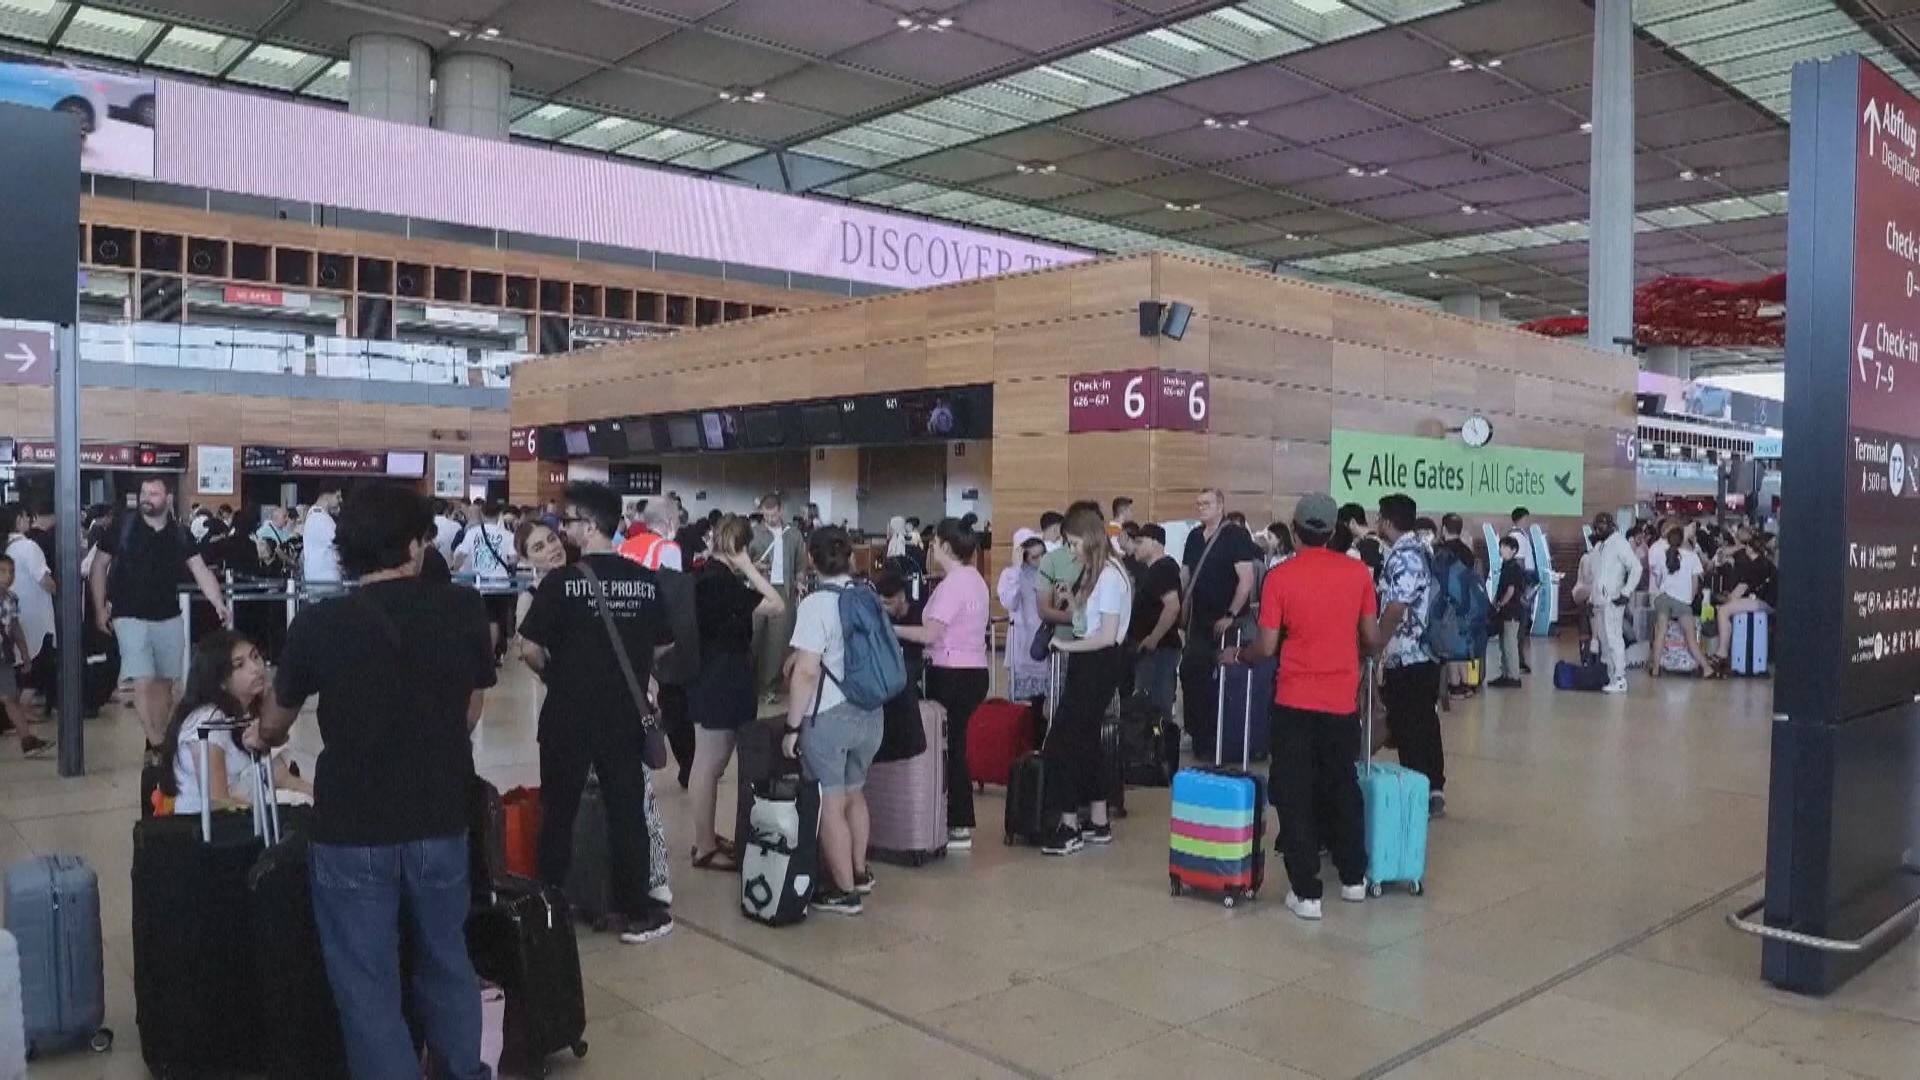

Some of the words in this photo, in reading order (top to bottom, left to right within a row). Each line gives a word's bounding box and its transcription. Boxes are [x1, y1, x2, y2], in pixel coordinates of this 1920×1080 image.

[1882, 102, 1916, 158] Abflug
[841, 220, 1012, 282] DISCOVER
[1877, 322, 1918, 363] Check-in
[1073, 378, 1111, 393] Check-in
[1124, 375, 1145, 419] 6
[1188, 380, 1206, 421] 6
[79, 450, 104, 463] way
[527, 429, 536, 454] 6
[1627, 435, 1635, 462] 6
[1855, 436, 1888, 464] Terminal
[1892, 456, 1902, 483] T2
[322, 458, 358, 469] Runway
[1368, 453, 1407, 488] Alle
[1414, 458, 1464, 491] Gates
[1479, 462, 1499, 493] All
[1505, 465, 1545, 496] Gates
[1868, 472, 1880, 491] 500
[565, 579, 608, 597] FUTUE
[611, 580, 656, 601] PROJECTS
